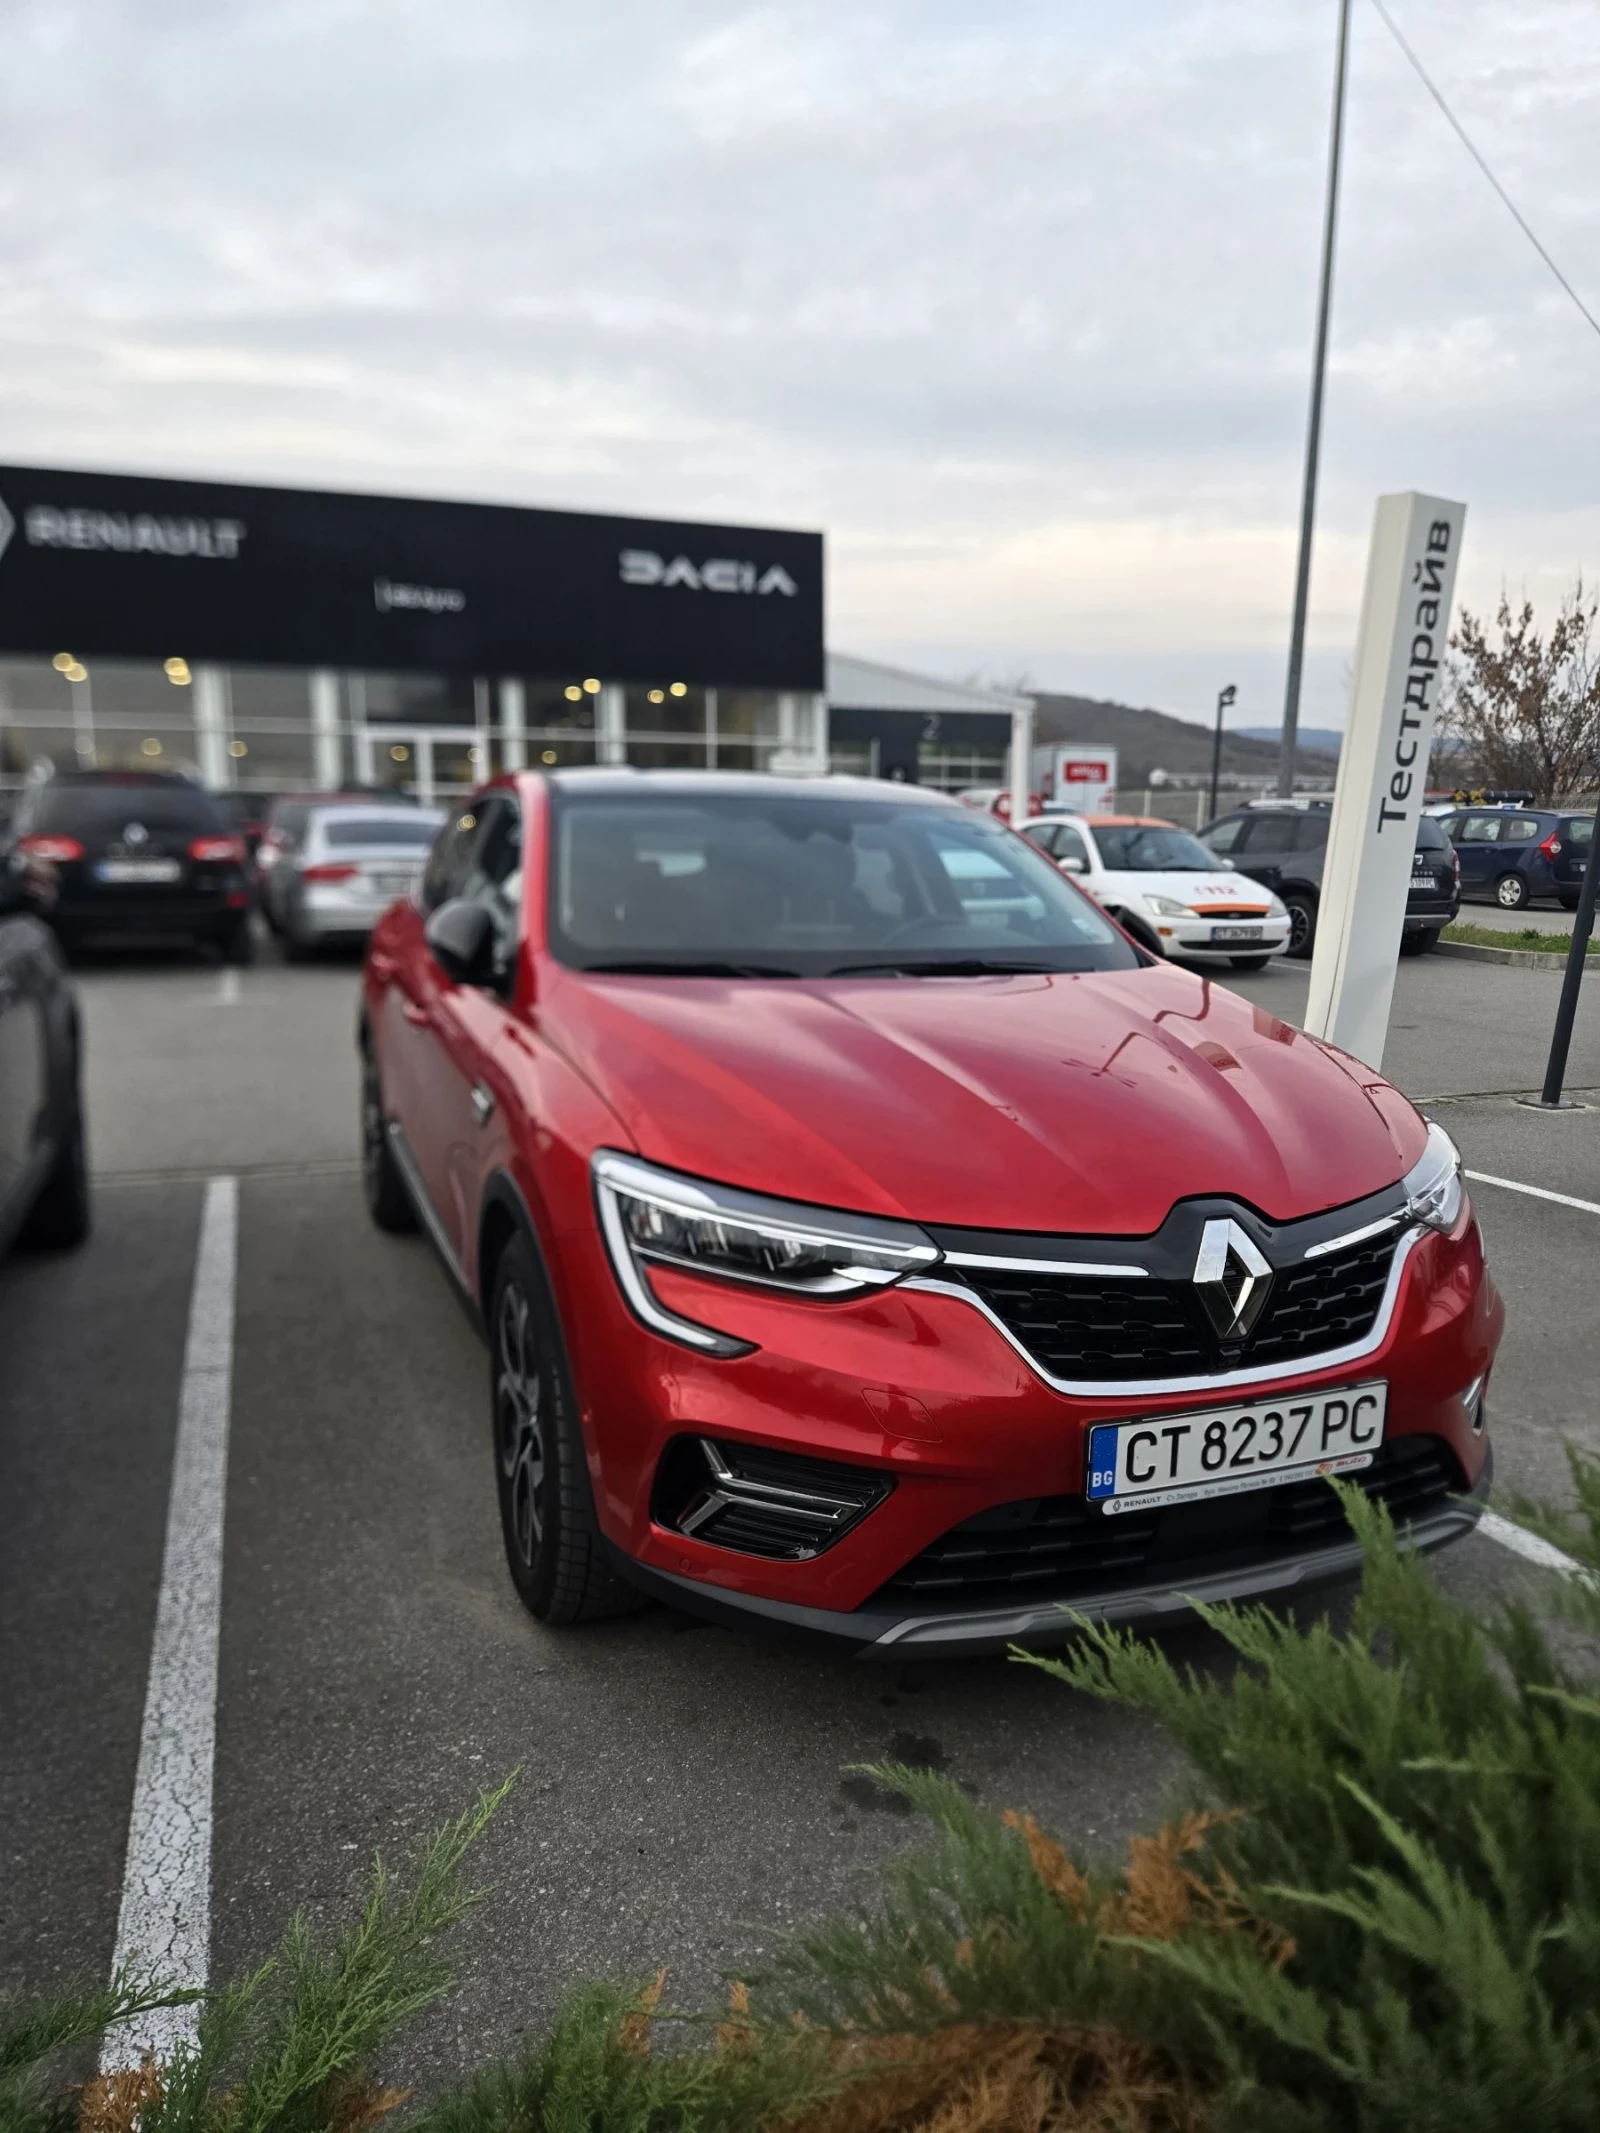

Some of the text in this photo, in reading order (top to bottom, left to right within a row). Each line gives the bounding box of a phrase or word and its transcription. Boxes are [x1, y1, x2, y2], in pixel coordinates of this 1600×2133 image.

[25, 505, 245, 558] RENAULT
[619, 548, 799, 597] DACIA
[1377, 518, 1453, 834] Тестдрайв
[1125, 1425, 1191, 1483] CT
[1200, 1405, 1314, 1471] 8237
[1320, 1394, 1378, 1451] PC
[1092, 1470, 1113, 1488] BG
[1123, 1496, 1162, 1508] RENAULT
